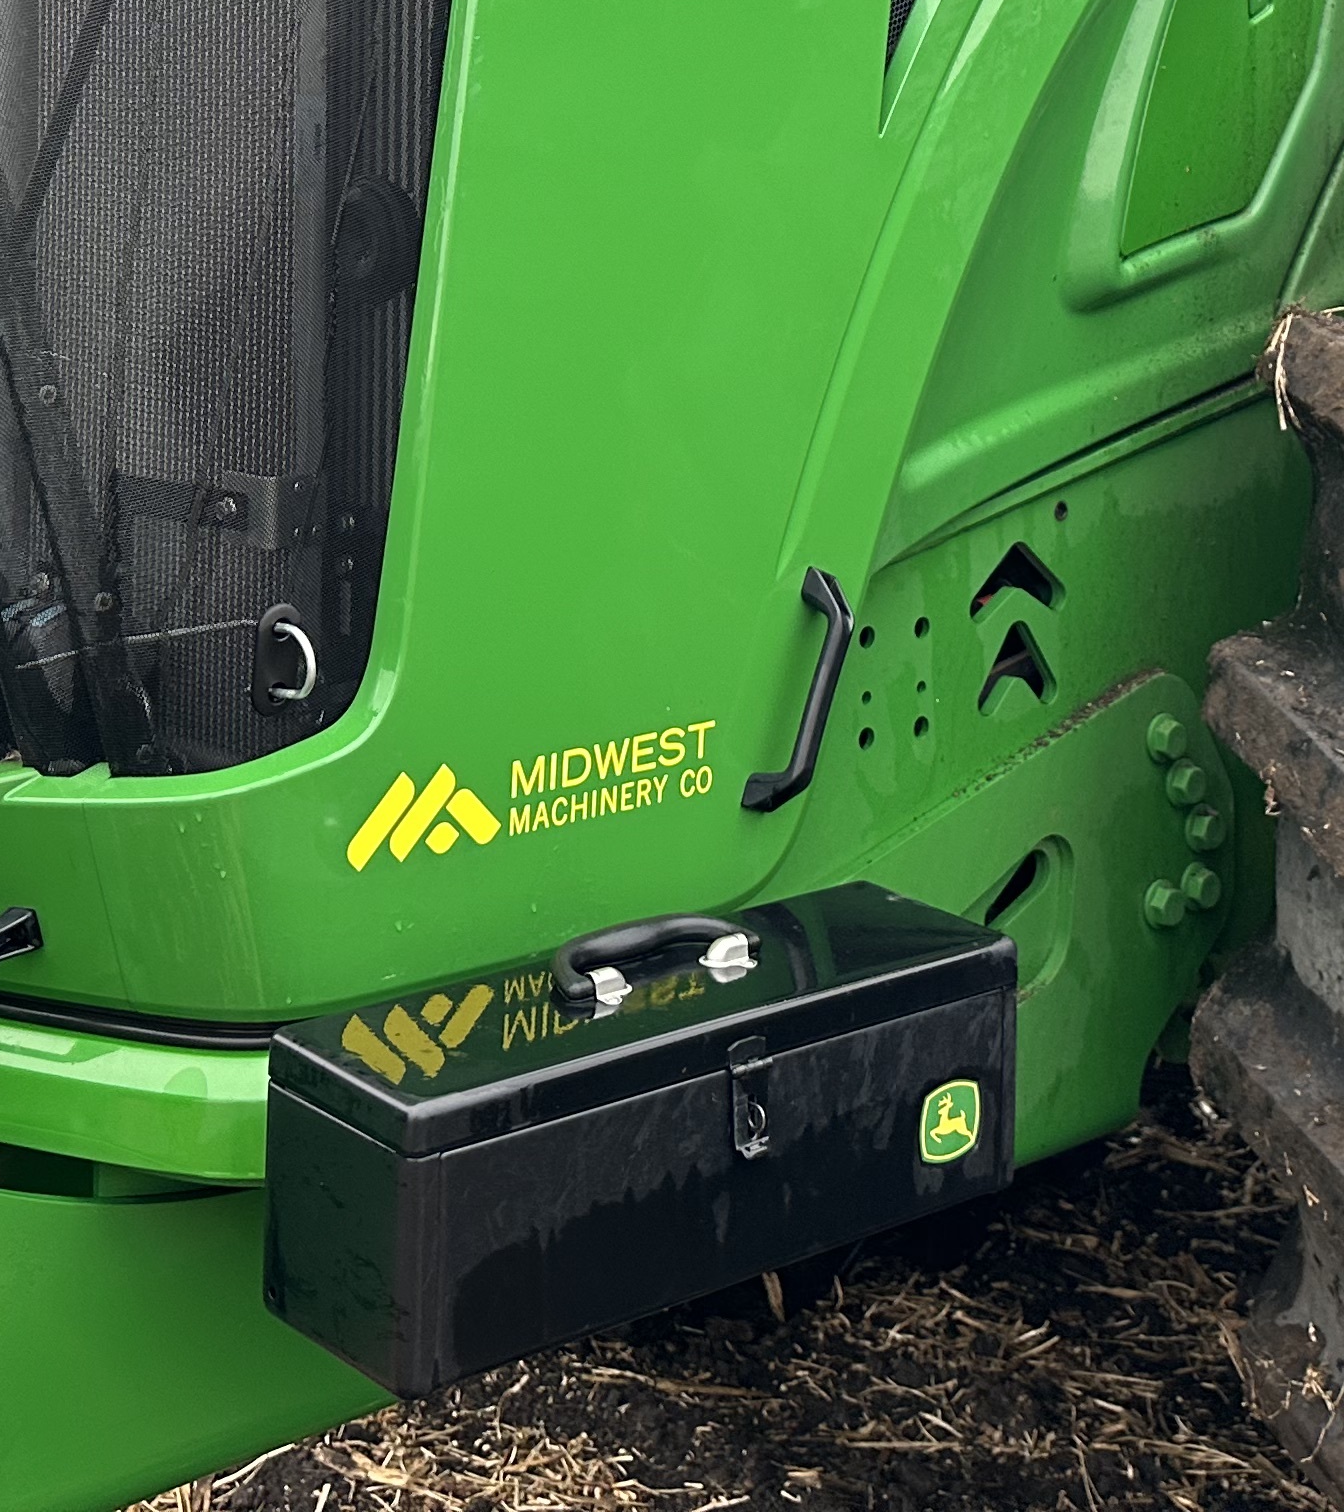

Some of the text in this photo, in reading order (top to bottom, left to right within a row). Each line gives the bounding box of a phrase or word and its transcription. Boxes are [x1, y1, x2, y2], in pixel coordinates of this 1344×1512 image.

[510, 719, 716, 799] MIDWEST
[509, 765, 713, 837] MACHINERY CO
